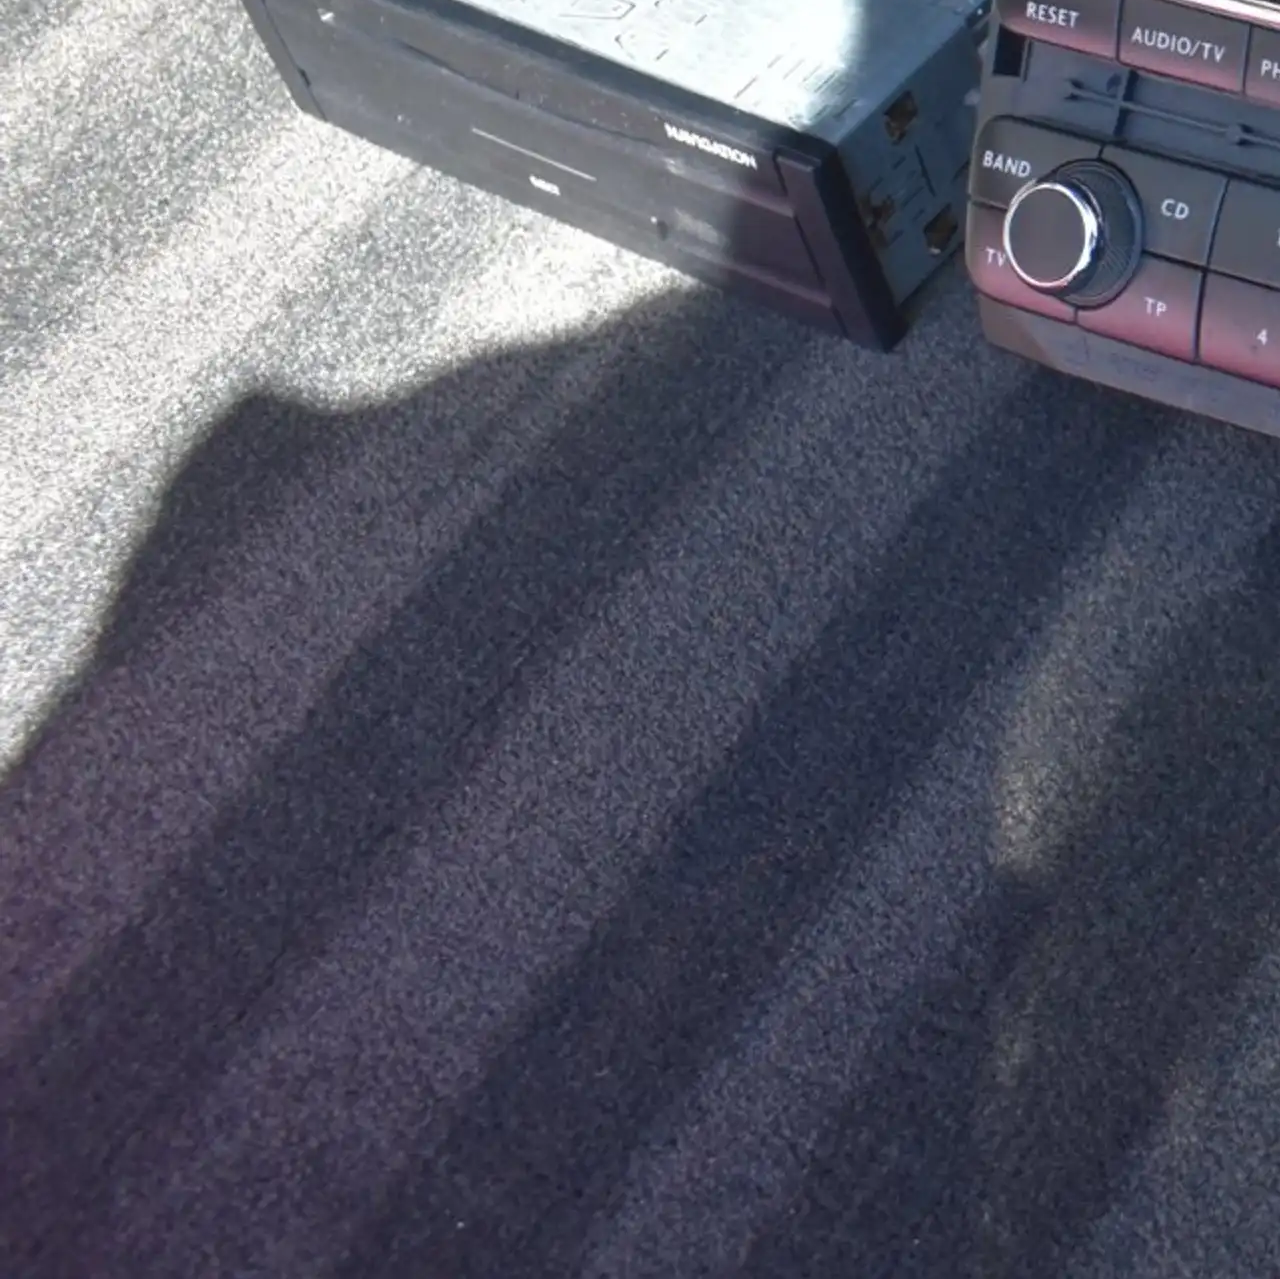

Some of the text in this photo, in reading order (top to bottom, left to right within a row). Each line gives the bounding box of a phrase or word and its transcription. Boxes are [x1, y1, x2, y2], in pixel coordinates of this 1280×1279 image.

[1026, 1, 1079, 28] RESET
[1131, 27, 1224, 62] AUDIO/TV
[982, 150, 1031, 178] BAND
[1161, 198, 1190, 220] CD
[1146, 297, 1167, 317] TP
[1257, 329, 1268, 345] 4
